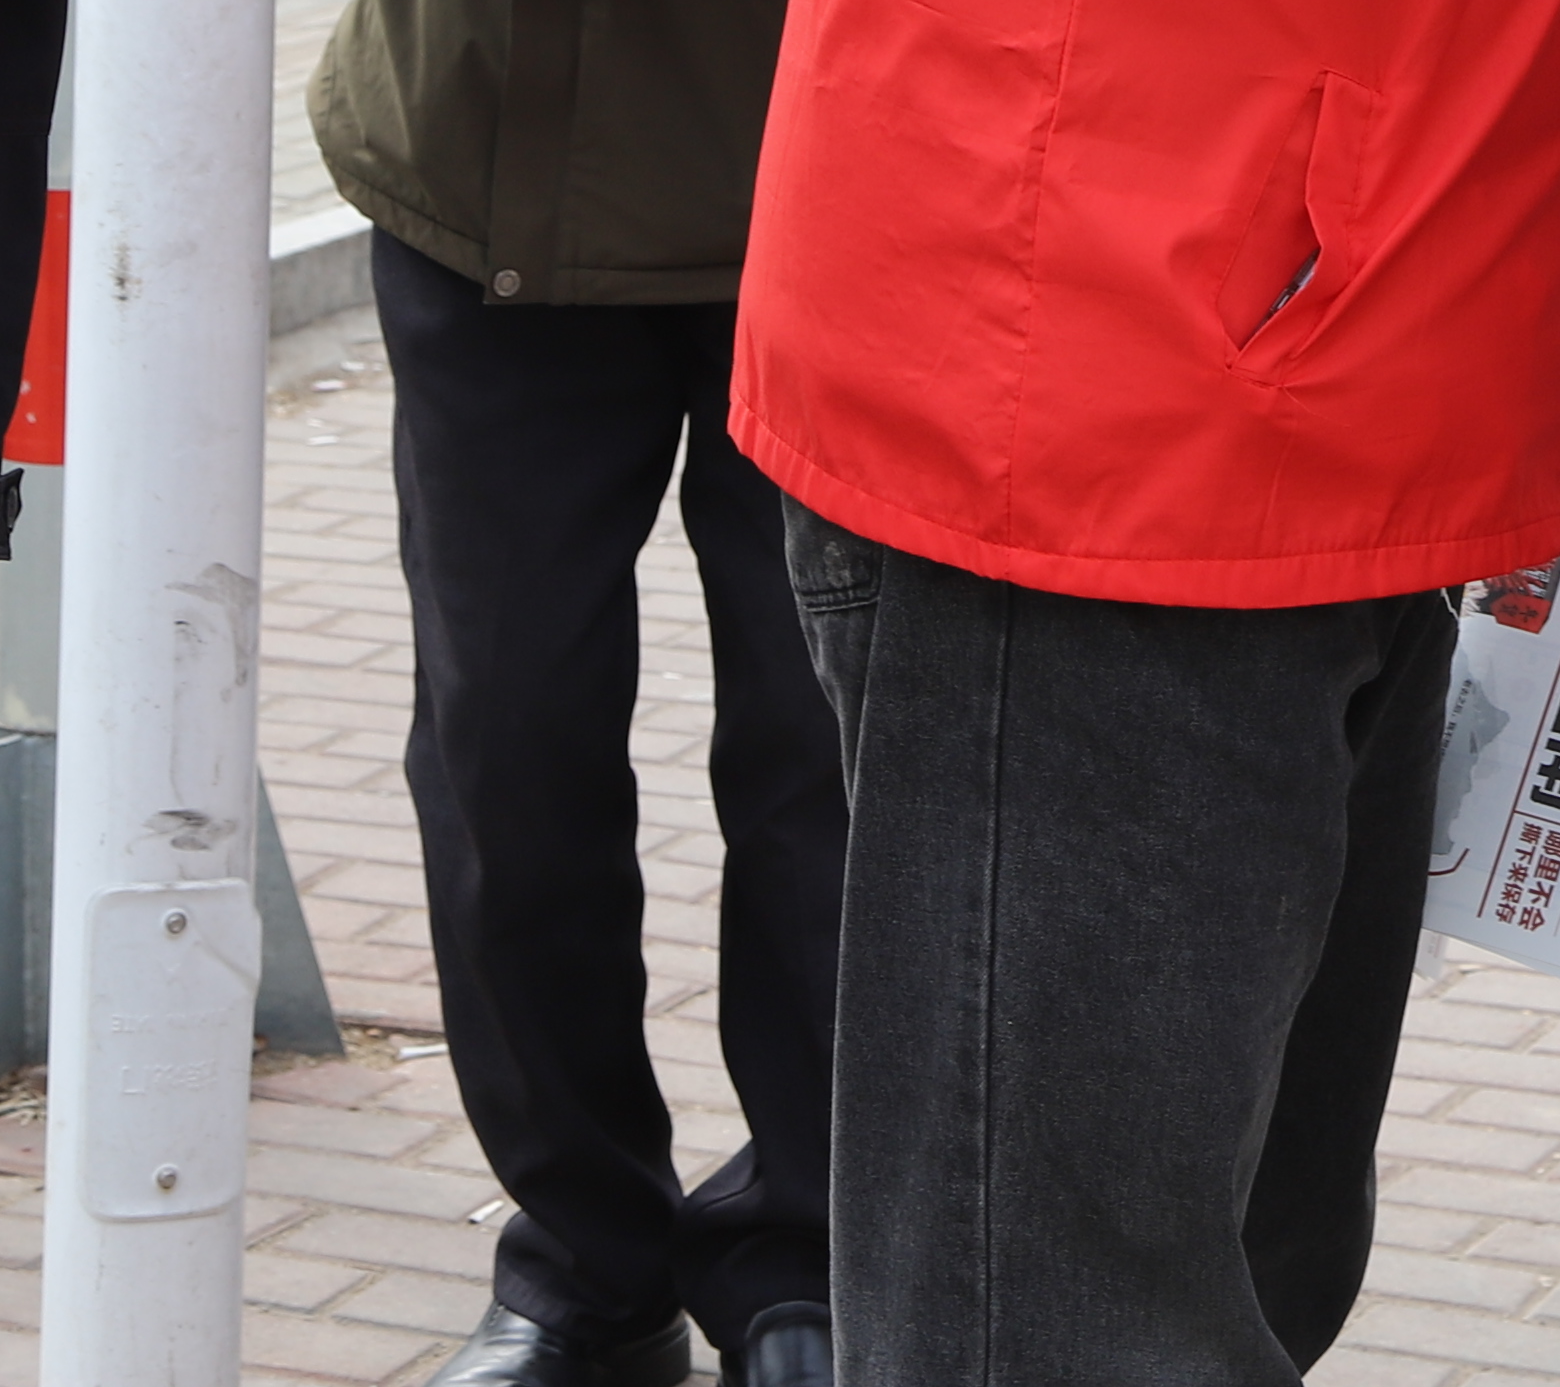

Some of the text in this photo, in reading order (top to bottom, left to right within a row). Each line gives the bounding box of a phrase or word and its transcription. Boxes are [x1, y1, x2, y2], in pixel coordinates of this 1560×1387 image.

[1495, 821, 1543, 924] 撕下来保存
